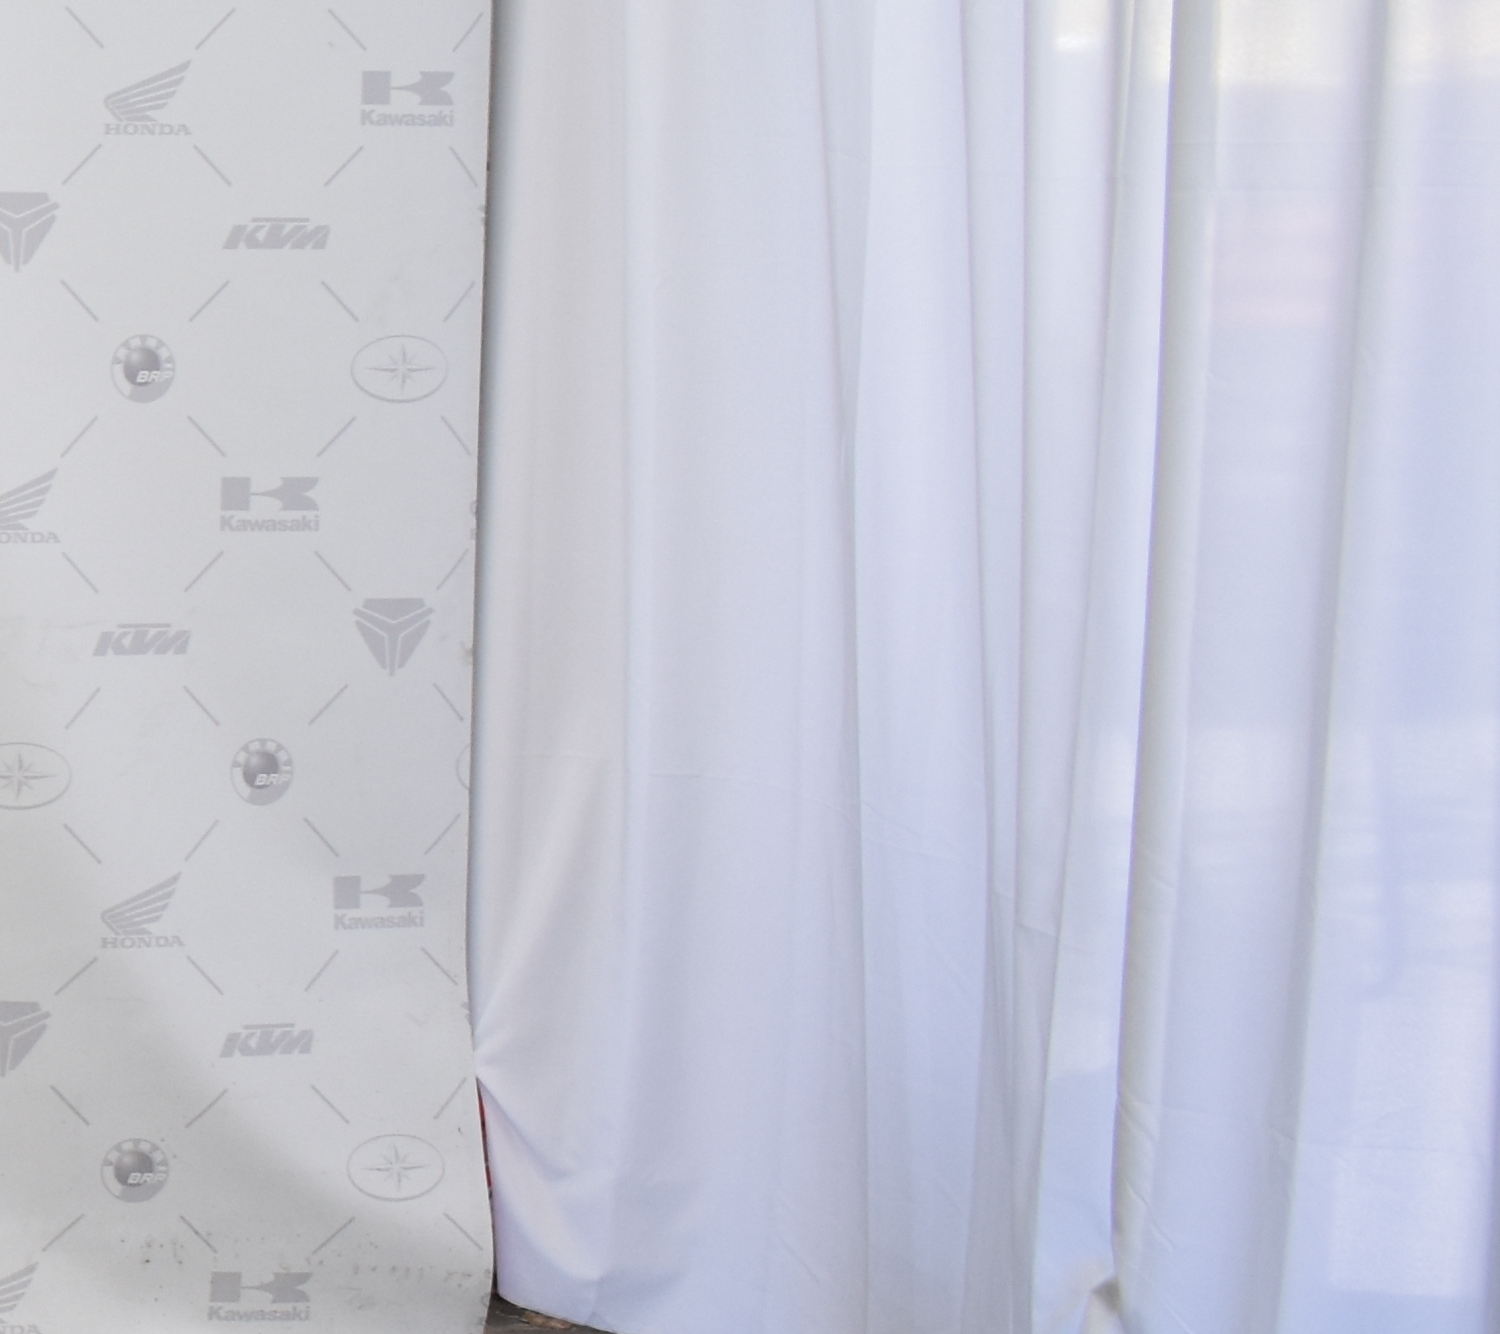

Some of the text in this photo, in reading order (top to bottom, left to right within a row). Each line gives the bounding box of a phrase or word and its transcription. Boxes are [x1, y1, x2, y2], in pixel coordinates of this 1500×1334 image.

[360, 106, 456, 130] Kawasaki
[104, 121, 192, 137] HONDA
[221, 216, 333, 252] KTM
[135, 369, 174, 384] BRP
[218, 512, 321, 534] Kawasaki
[91, 621, 192, 657] KTM
[332, 910, 425, 931] Kawasaki
[101, 934, 186, 950] HONDA
[218, 1021, 316, 1058] KTM
[206, 1304, 312, 1324] Kawasaki
